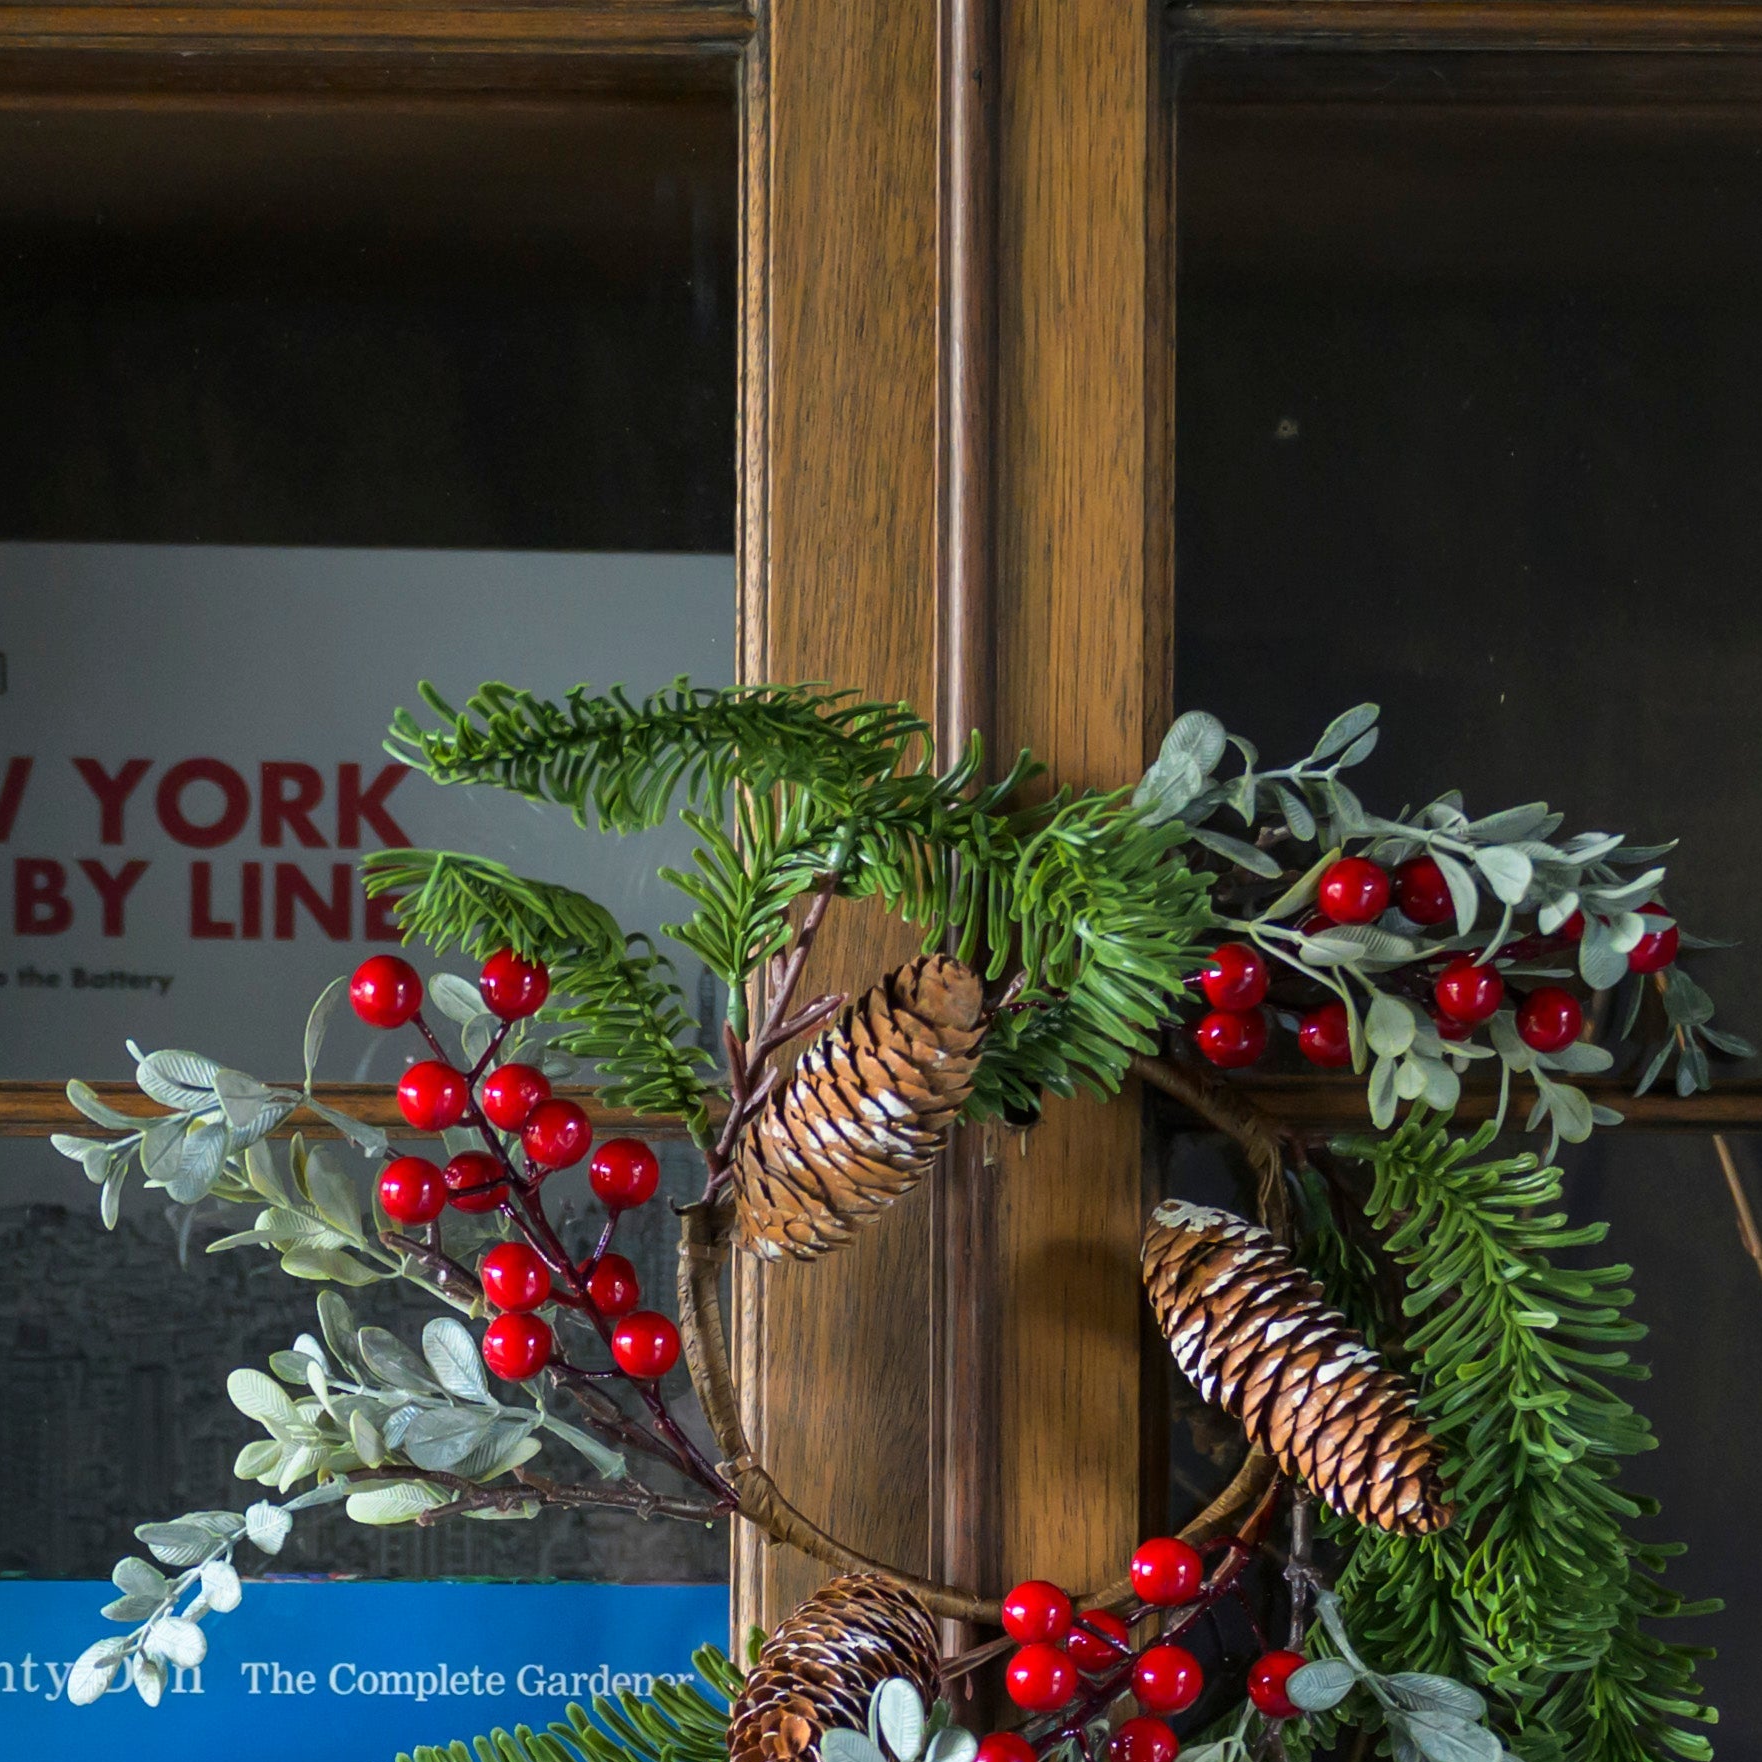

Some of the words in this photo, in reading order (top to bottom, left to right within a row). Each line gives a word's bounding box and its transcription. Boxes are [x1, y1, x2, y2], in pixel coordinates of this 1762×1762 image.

[71, 756, 416, 851] YORK
[14, 857, 152, 938] BY
[70, 965, 175, 996] Battery
[102, 1655, 205, 1694] Dn
[241, 1662, 316, 1695] The
[329, 1663, 506, 1702] Complete
